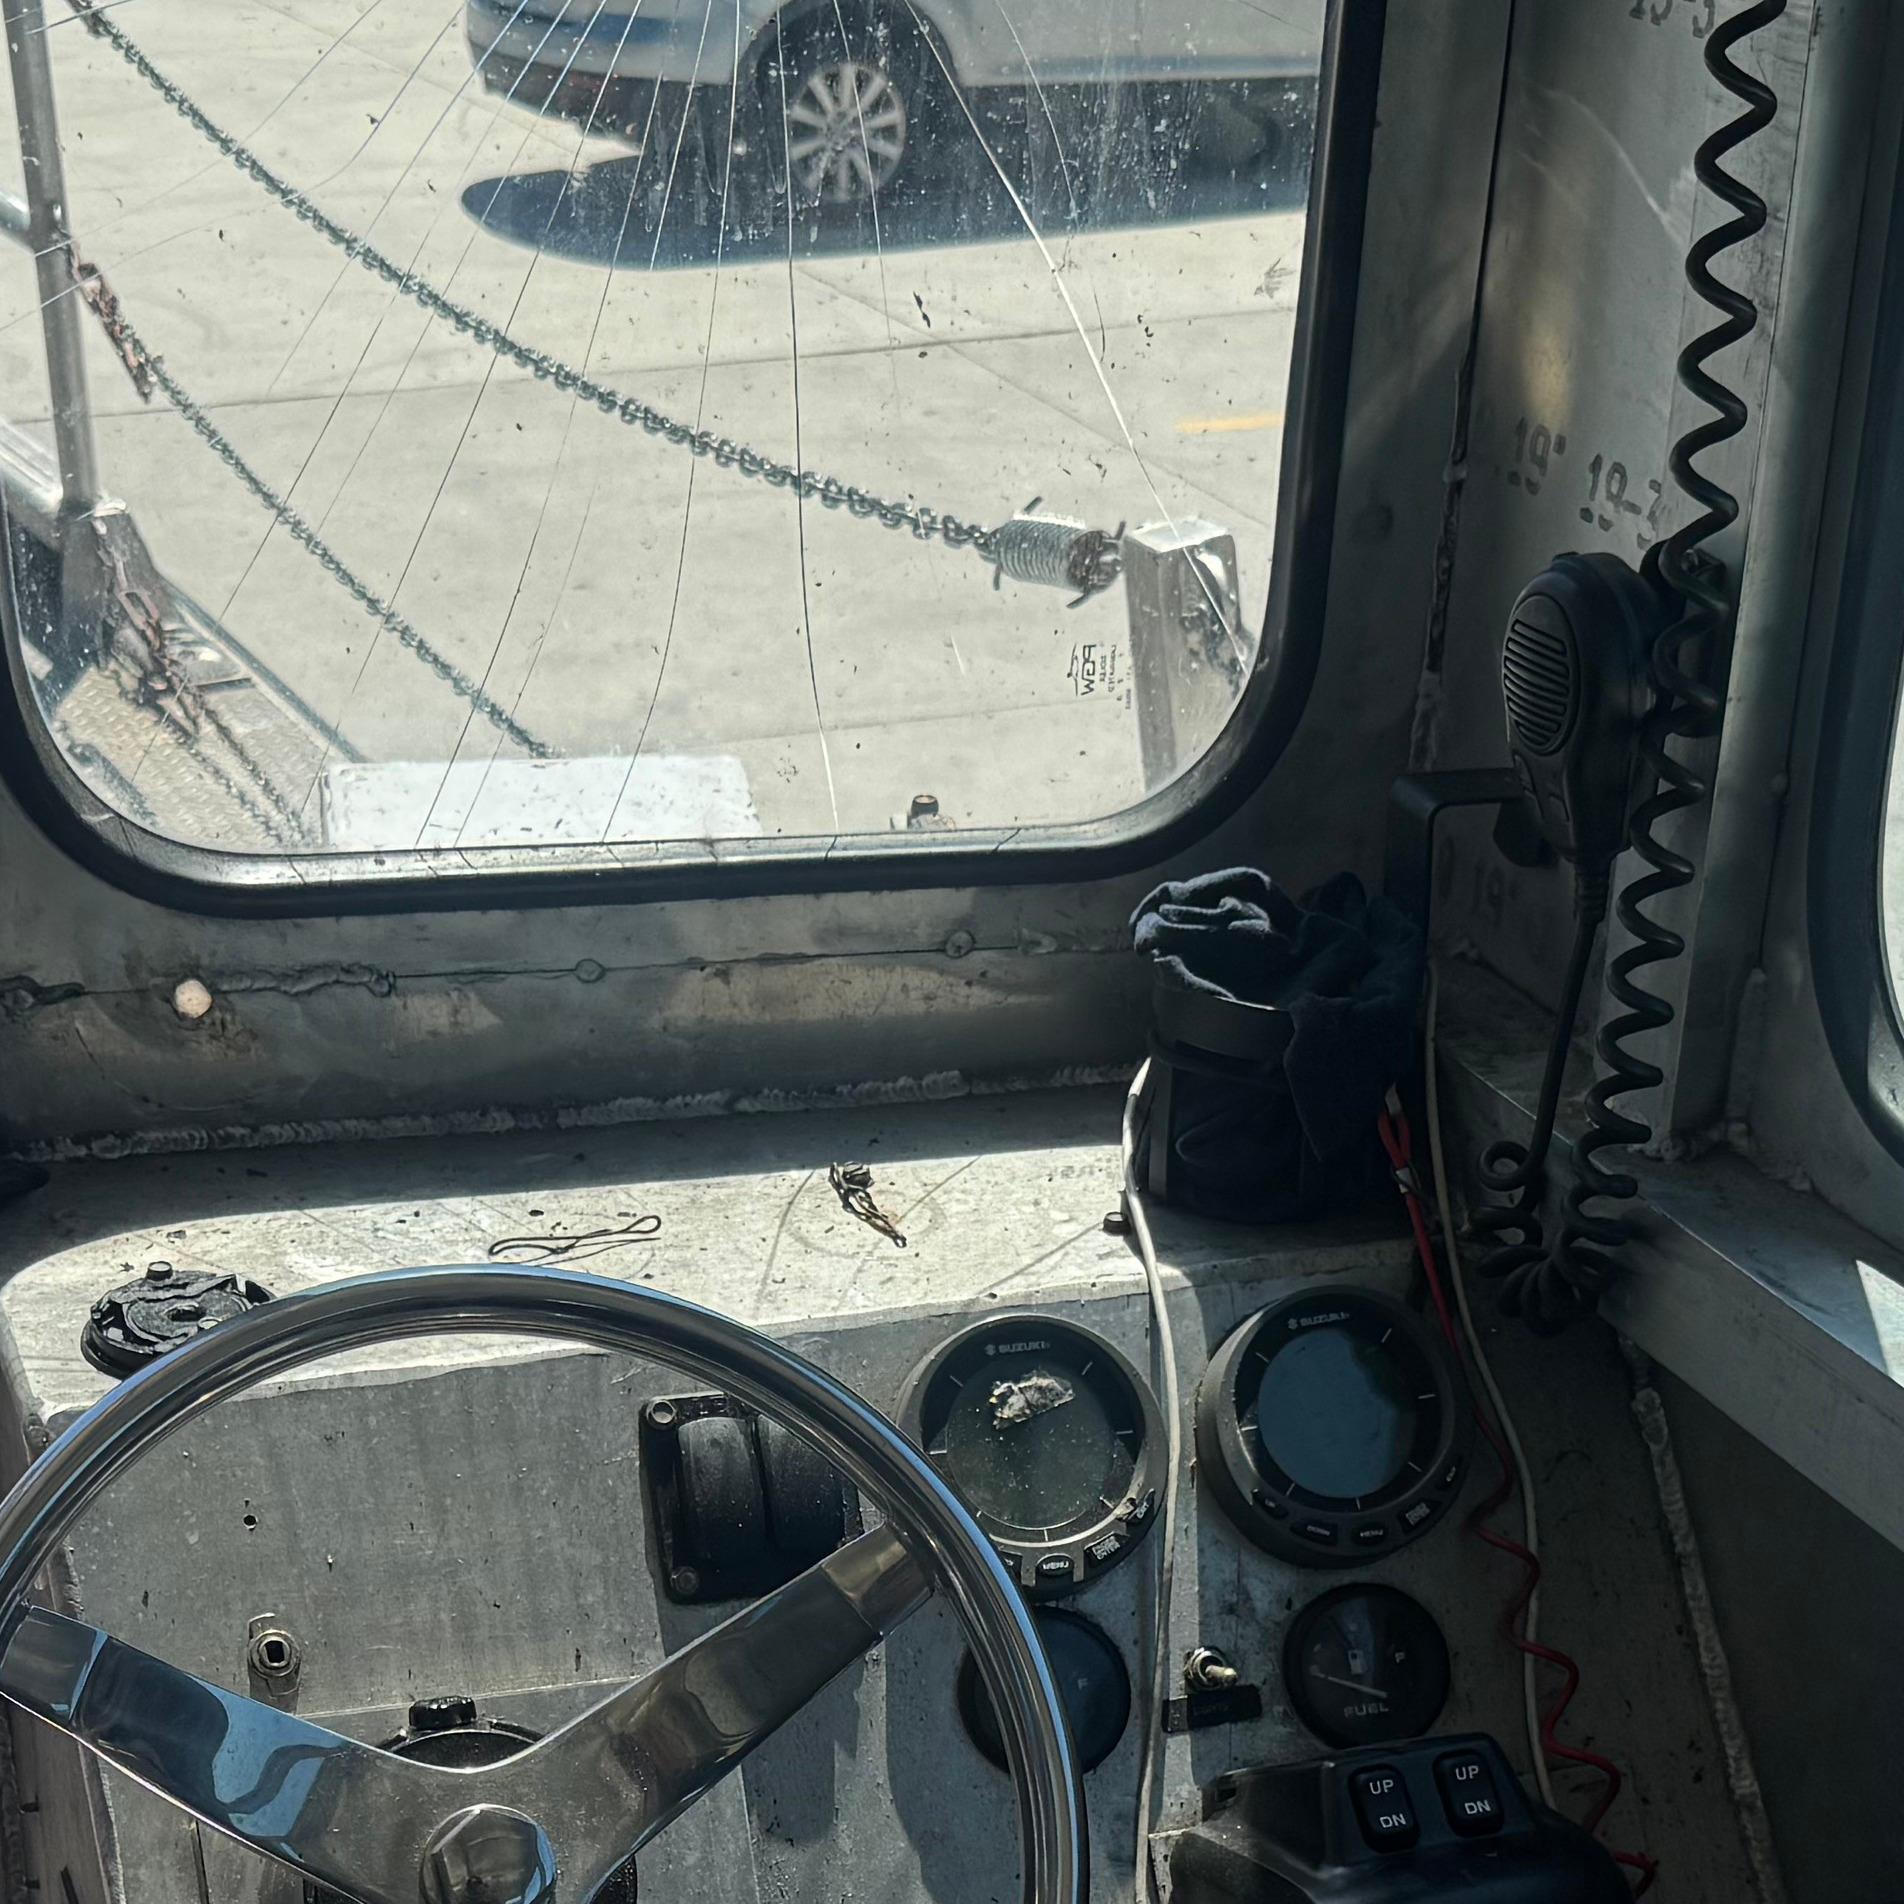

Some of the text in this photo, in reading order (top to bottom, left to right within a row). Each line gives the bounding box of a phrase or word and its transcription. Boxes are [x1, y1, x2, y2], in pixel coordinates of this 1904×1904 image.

[998, 1340, 1045, 1355] SUZUKI
[1343, 1702, 1390, 1720] FUEL
[1455, 1764, 1480, 1781] UP
[1368, 1778, 1395, 1796] UP
[1464, 1799, 1492, 1816] DN
[1380, 1812, 1408, 1829] DN
